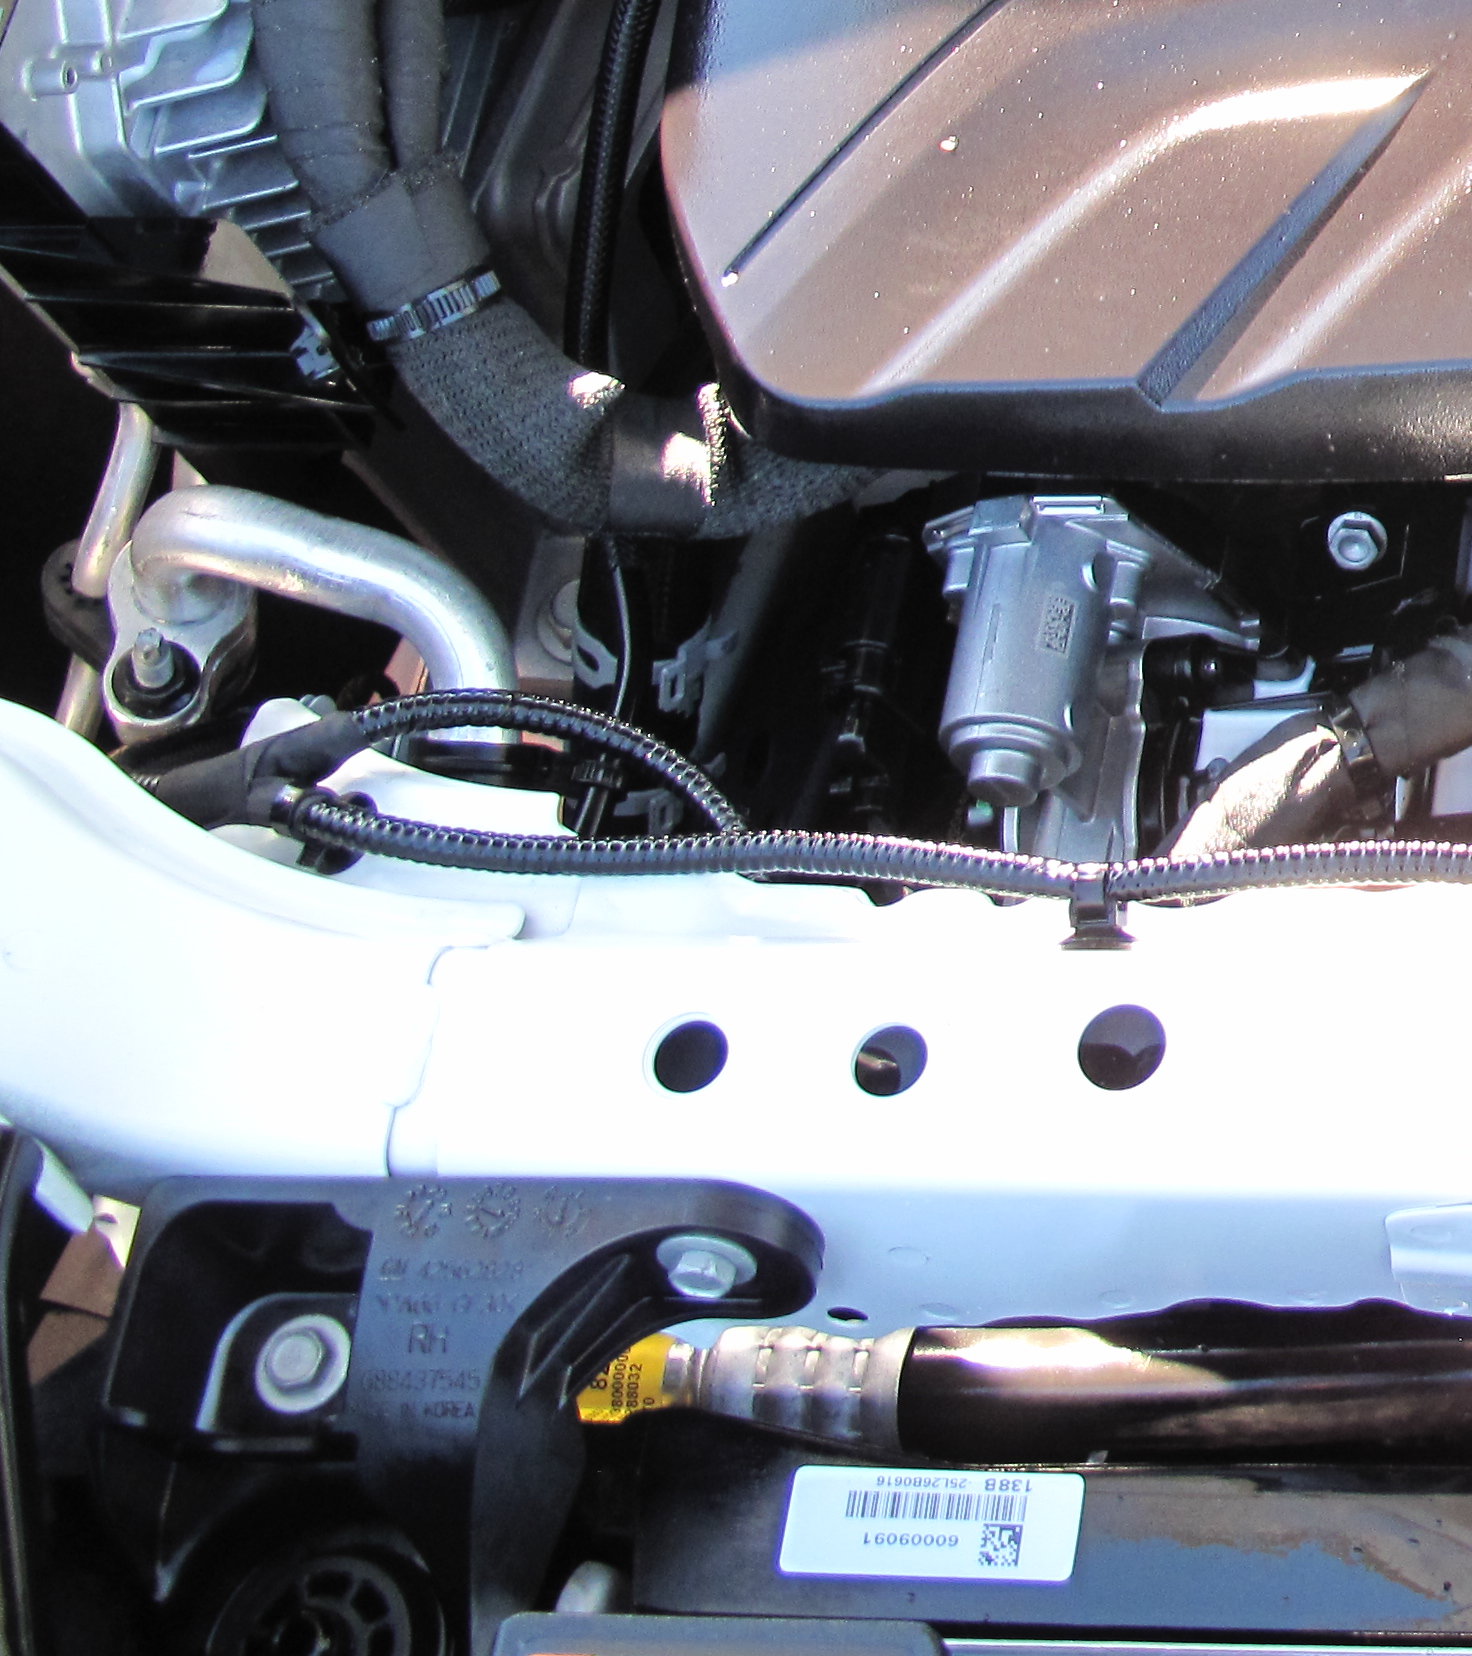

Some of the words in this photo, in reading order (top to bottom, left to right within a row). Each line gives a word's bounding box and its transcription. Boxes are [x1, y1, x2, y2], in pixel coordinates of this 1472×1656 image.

[407, 1322, 450, 1354] RH
[982, 1476, 1034, 1494] 138B
[860, 1530, 960, 1548] 60009091
